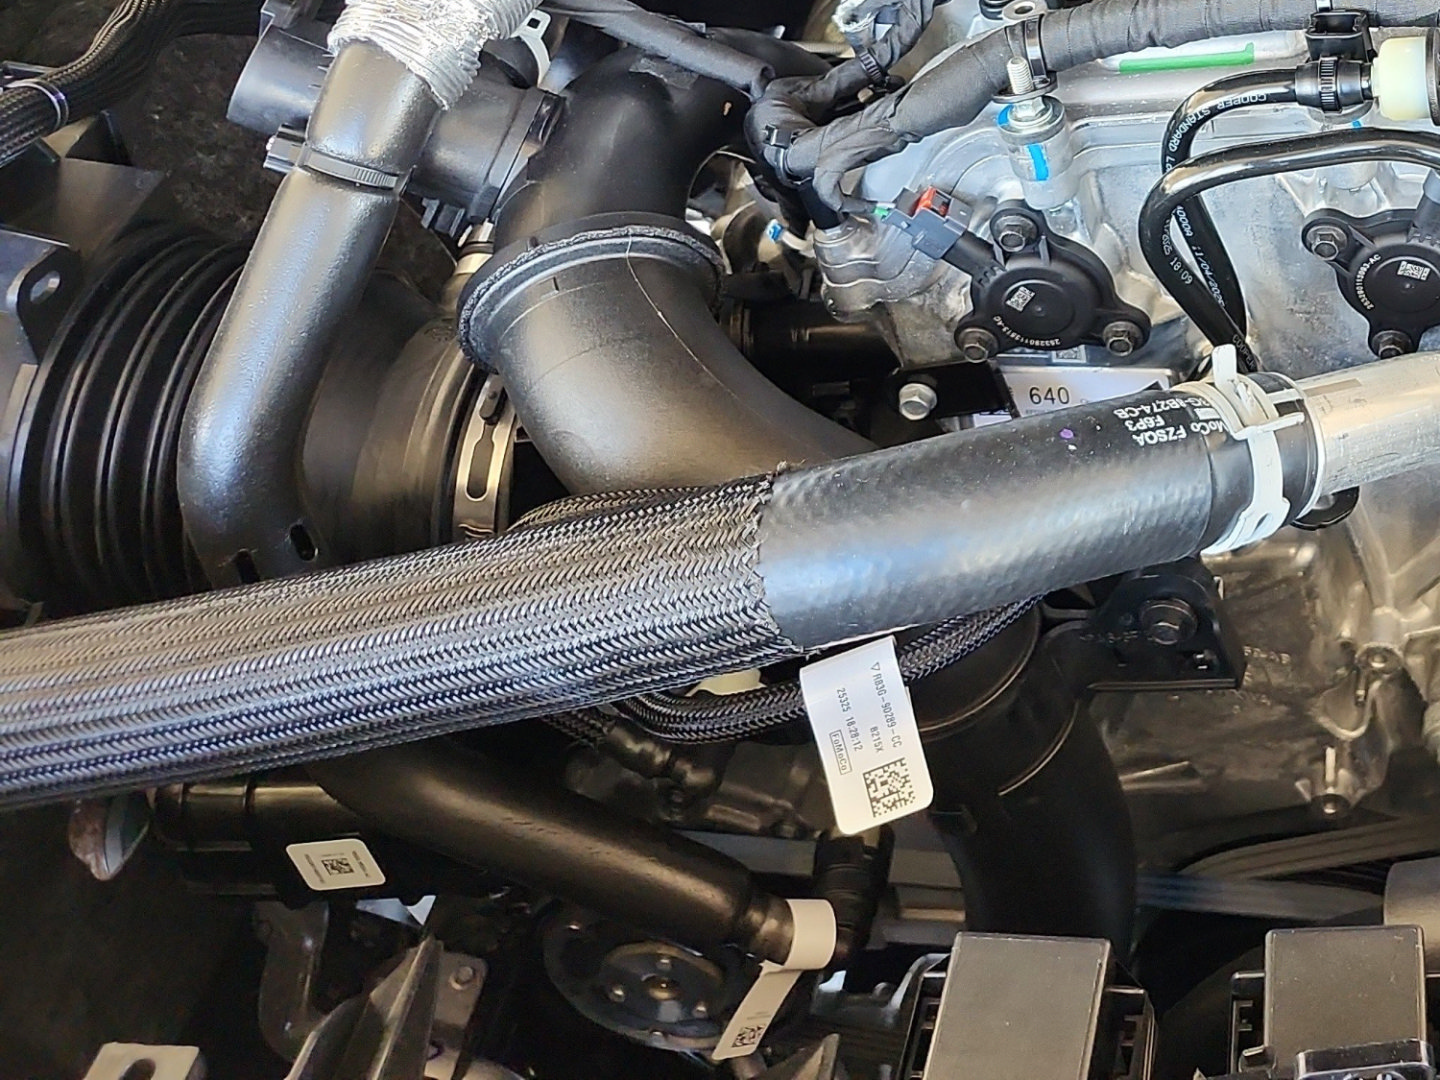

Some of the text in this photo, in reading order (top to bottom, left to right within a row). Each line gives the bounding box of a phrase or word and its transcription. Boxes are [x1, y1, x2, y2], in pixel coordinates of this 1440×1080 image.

[1216, 93, 1267, 110] COOPER
[1167, 107, 1211, 152] STANDARD
[1028, 386, 1071, 405] 640
[836, 687, 852, 713] 25325
[831, 733, 848, 772] FoMoCo
